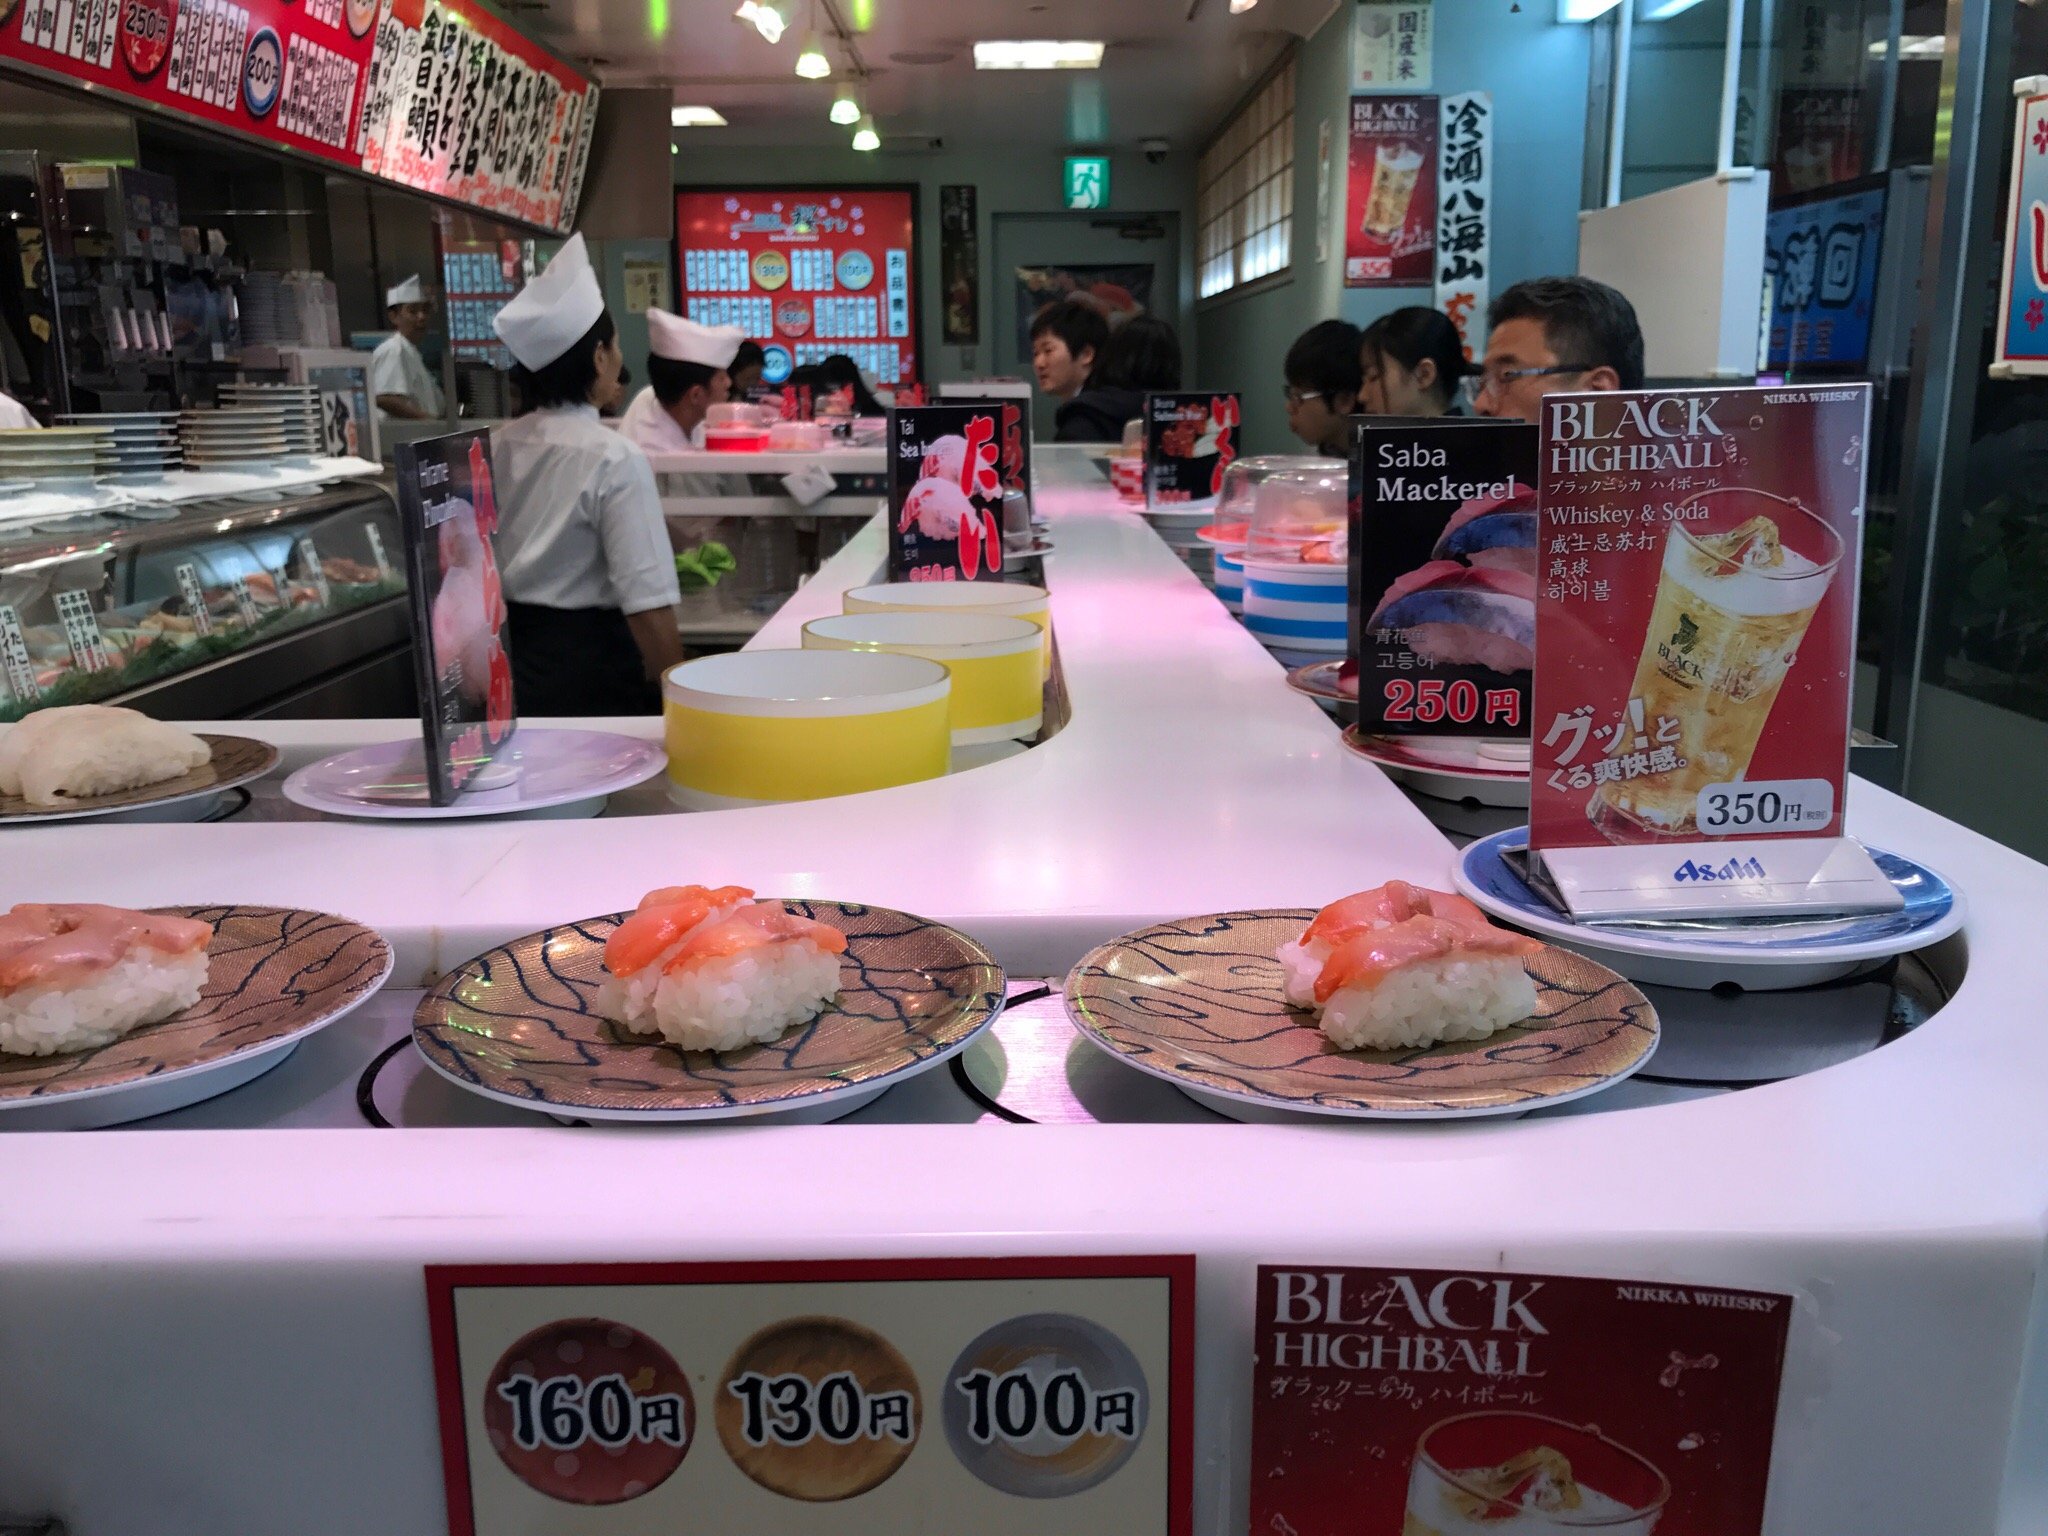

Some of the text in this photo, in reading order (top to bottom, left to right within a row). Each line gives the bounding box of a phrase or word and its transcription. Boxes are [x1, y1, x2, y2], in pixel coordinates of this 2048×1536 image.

[403, 9, 441, 140] 金目鯛
[1354, 103, 1420, 120] BLACK
[1441, 99, 1488, 285] 冷酒八海山
[1763, 391, 1860, 405] NIKKA WHISKY
[900, 418, 915, 436] Tai
[1550, 397, 1725, 441] BLACK
[900, 442, 918, 460] Sea
[1378, 442, 1447, 468] Saba
[1550, 442, 1724, 474] HIGHBALL
[1376, 474, 1516, 502] Mackerel
[1549, 478, 1722, 496] ブラックニッカ ハイボール
[1549, 502, 1710, 529] Whiskey & Soda
[1549, 532, 1657, 554] 威士忌苏打
[1549, 559, 1592, 579] 高球
[1548, 580, 1613, 603] 하이볼
[1376, 652, 1435, 670] 고등어
[1384, 679, 1521, 726] 250円
[1673, 857, 1767, 883] Asahi
[1272, 1273, 1550, 1336] BLACK
[1616, 1286, 1779, 1313] NIKKA WHISKY
[1274, 1332, 1548, 1378] HIGHBALL
[961, 1372, 1136, 1439] 100円
[1428, 1385, 1543, 1405] ハイボール
[504, 1375, 683, 1446] 160円
[734, 1376, 911, 1442] 130円
